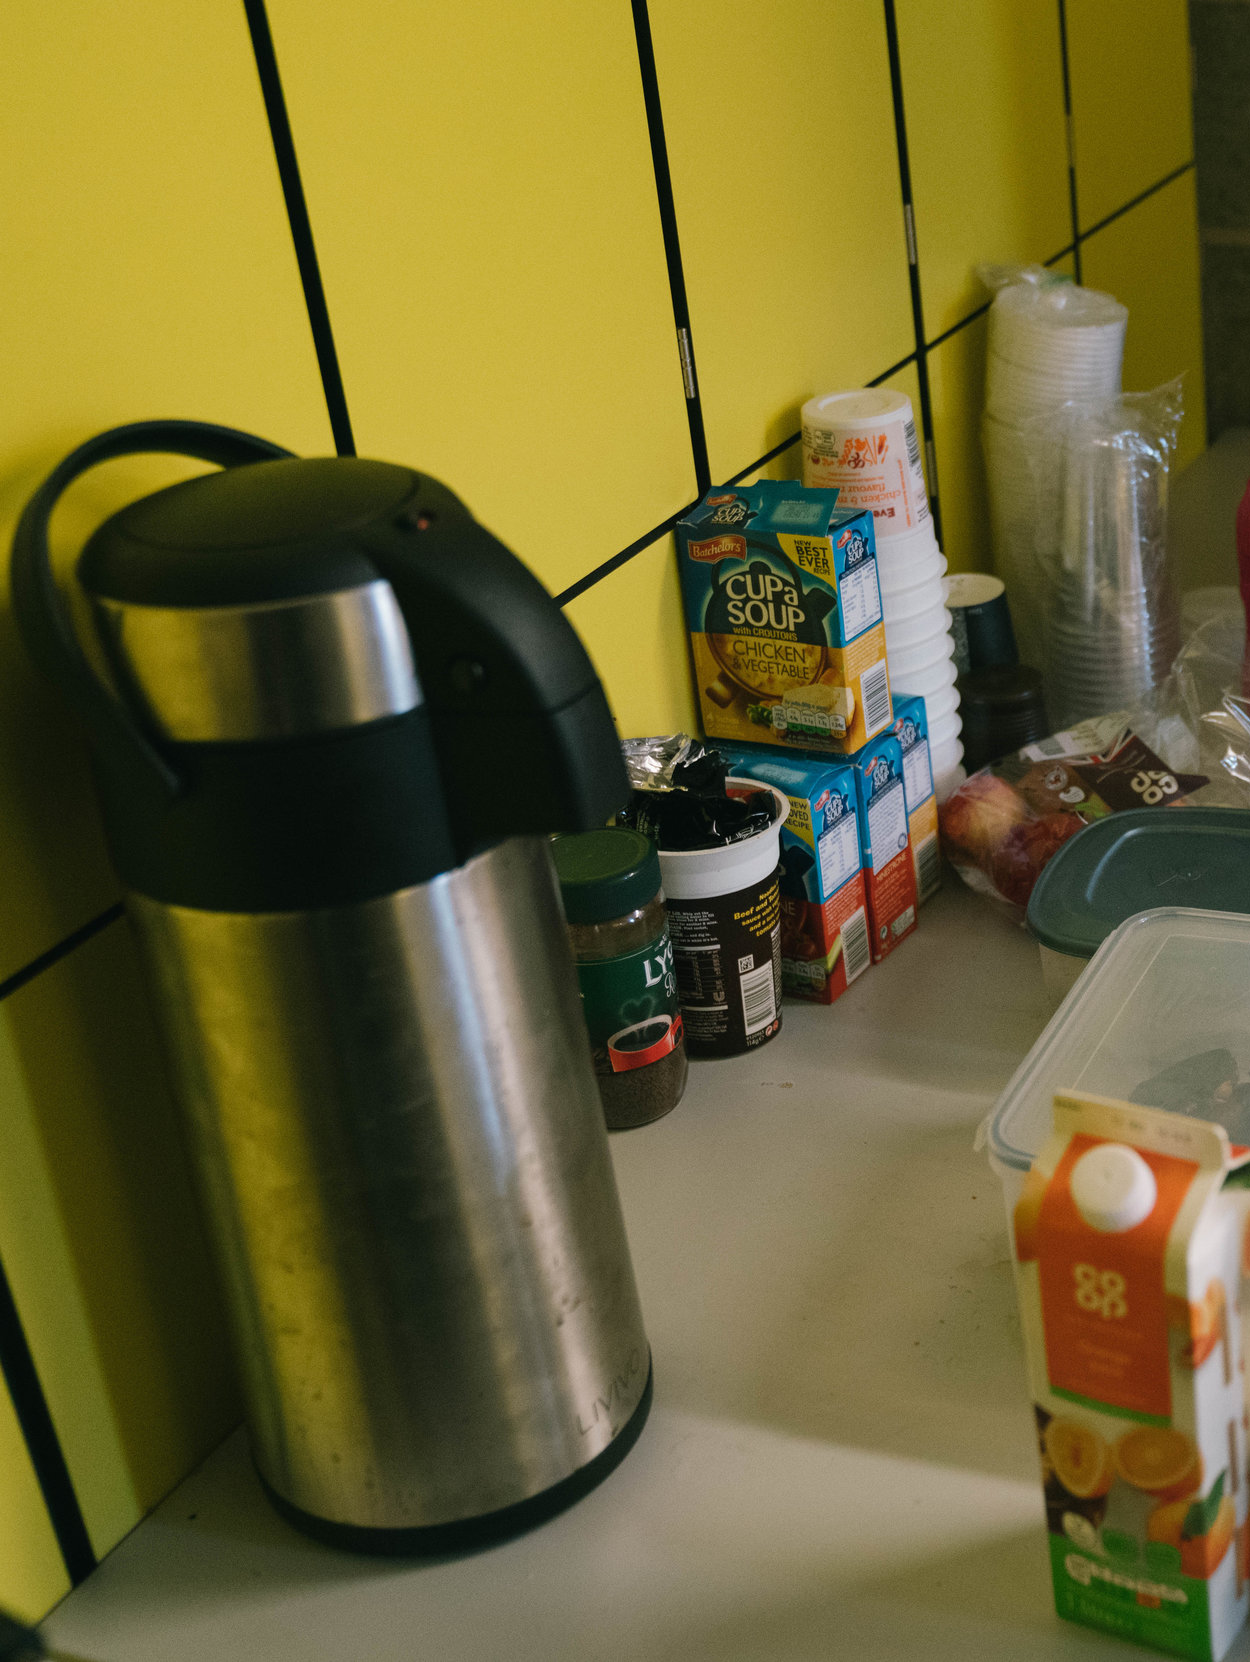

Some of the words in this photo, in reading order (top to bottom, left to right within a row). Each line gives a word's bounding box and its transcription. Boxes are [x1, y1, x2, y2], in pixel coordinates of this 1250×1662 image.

[861, 490, 901, 503] chicken
[796, 546, 828, 557] BEST
[848, 547, 865, 566] SOUP
[799, 556, 830, 570] EVER
[813, 566, 831, 576] RECIPE
[727, 599, 806, 631] SOUP
[733, 626, 752, 635] with
[752, 627, 798, 641] CROUTONS
[733, 640, 806, 664] CHICKEN
[733, 660, 743, 670] &
[743, 659, 810, 680] VEGETABLE
[877, 852, 908, 881] MINESTRONE
[734, 906, 755, 920] Beef
[755, 899, 768, 912] and
[741, 914, 761, 926] sauce
[749, 922, 761, 932] and
